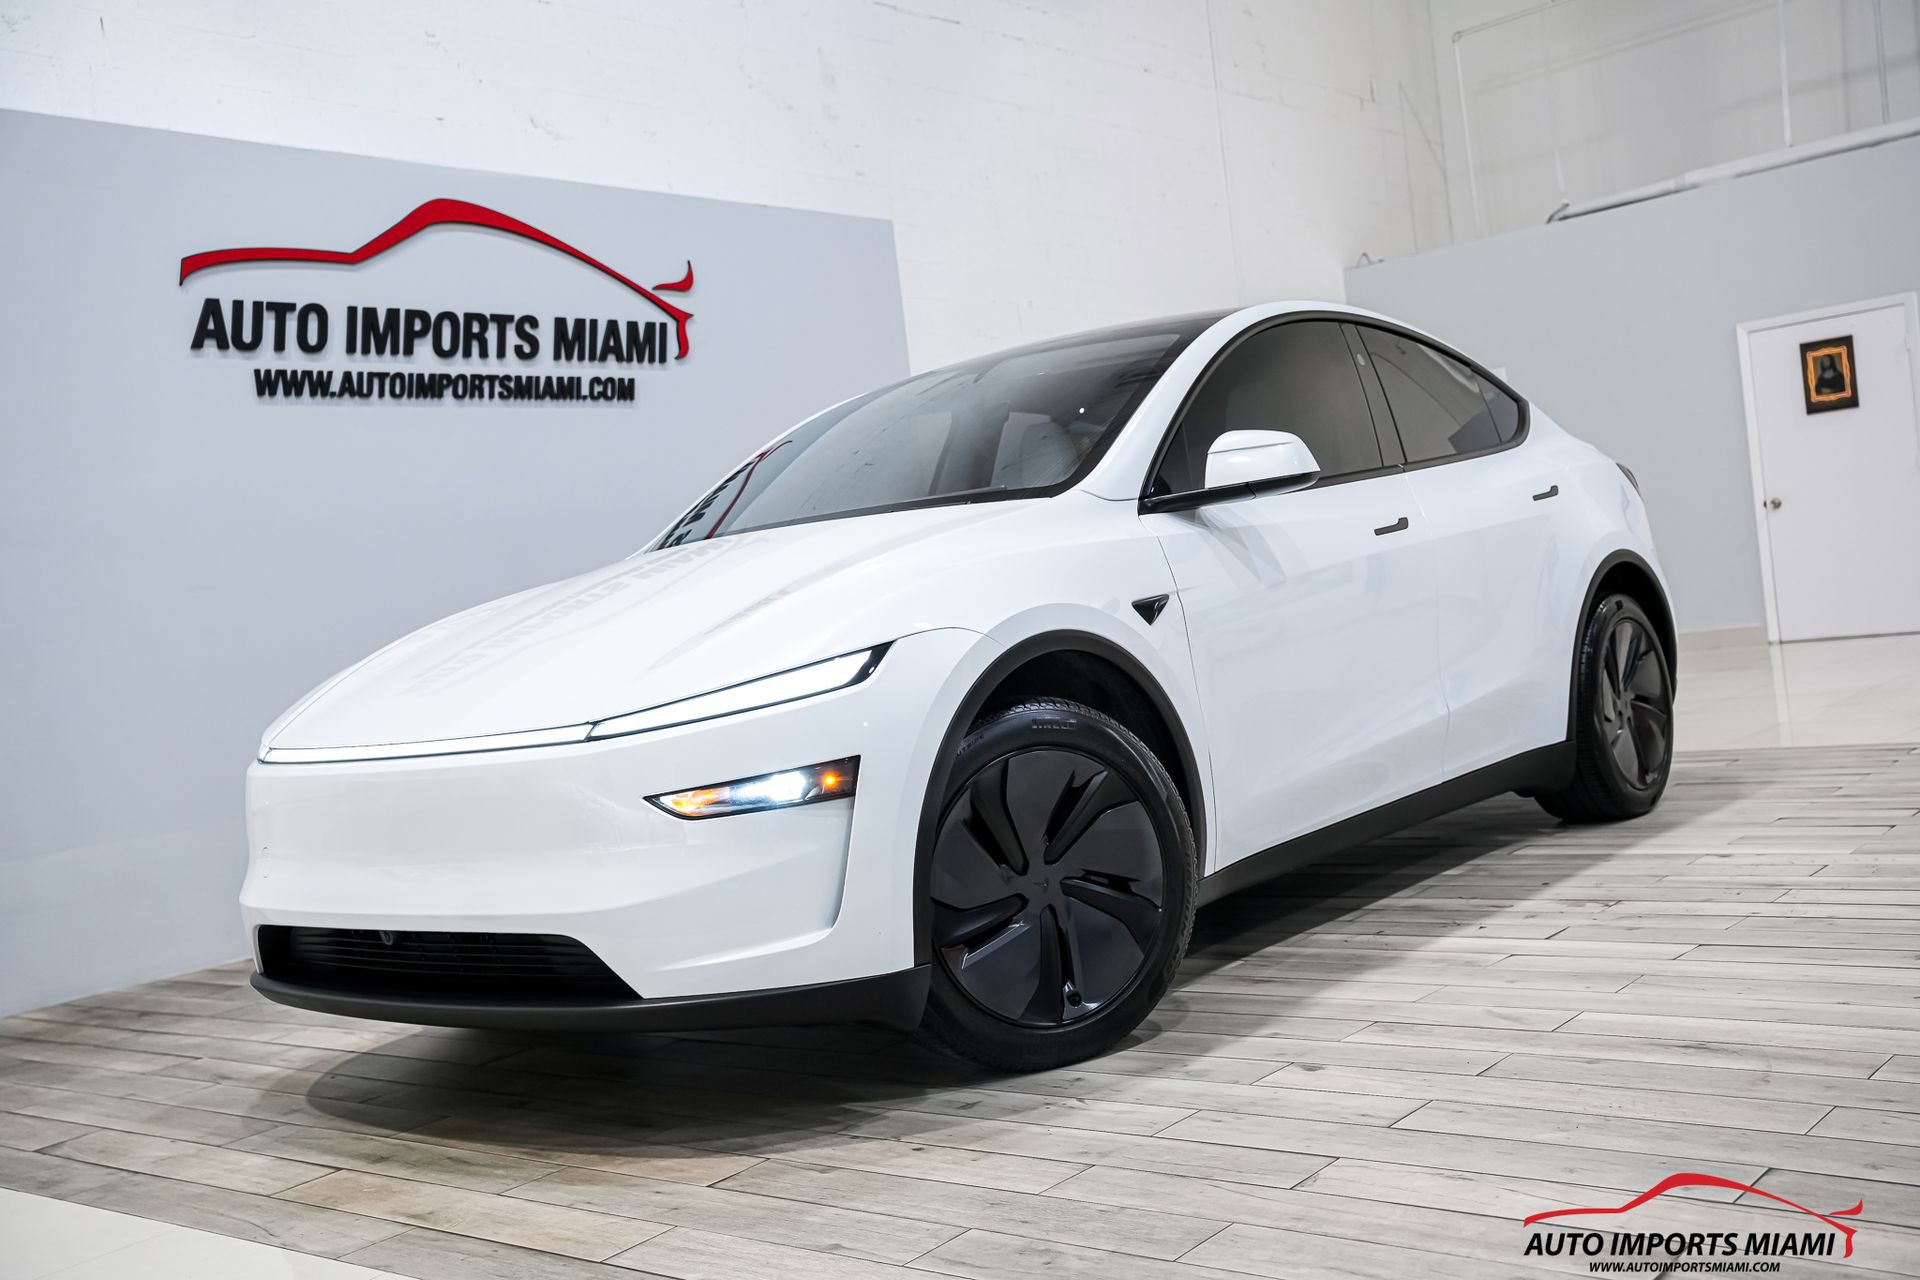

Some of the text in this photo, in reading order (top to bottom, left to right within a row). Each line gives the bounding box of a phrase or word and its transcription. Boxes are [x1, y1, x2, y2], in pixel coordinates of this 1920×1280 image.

[190, 297, 669, 365] AUTO IMPORTS MIAMI
[253, 368, 635, 402] WWW.AUTOIMPORTSMIAMI.COM
